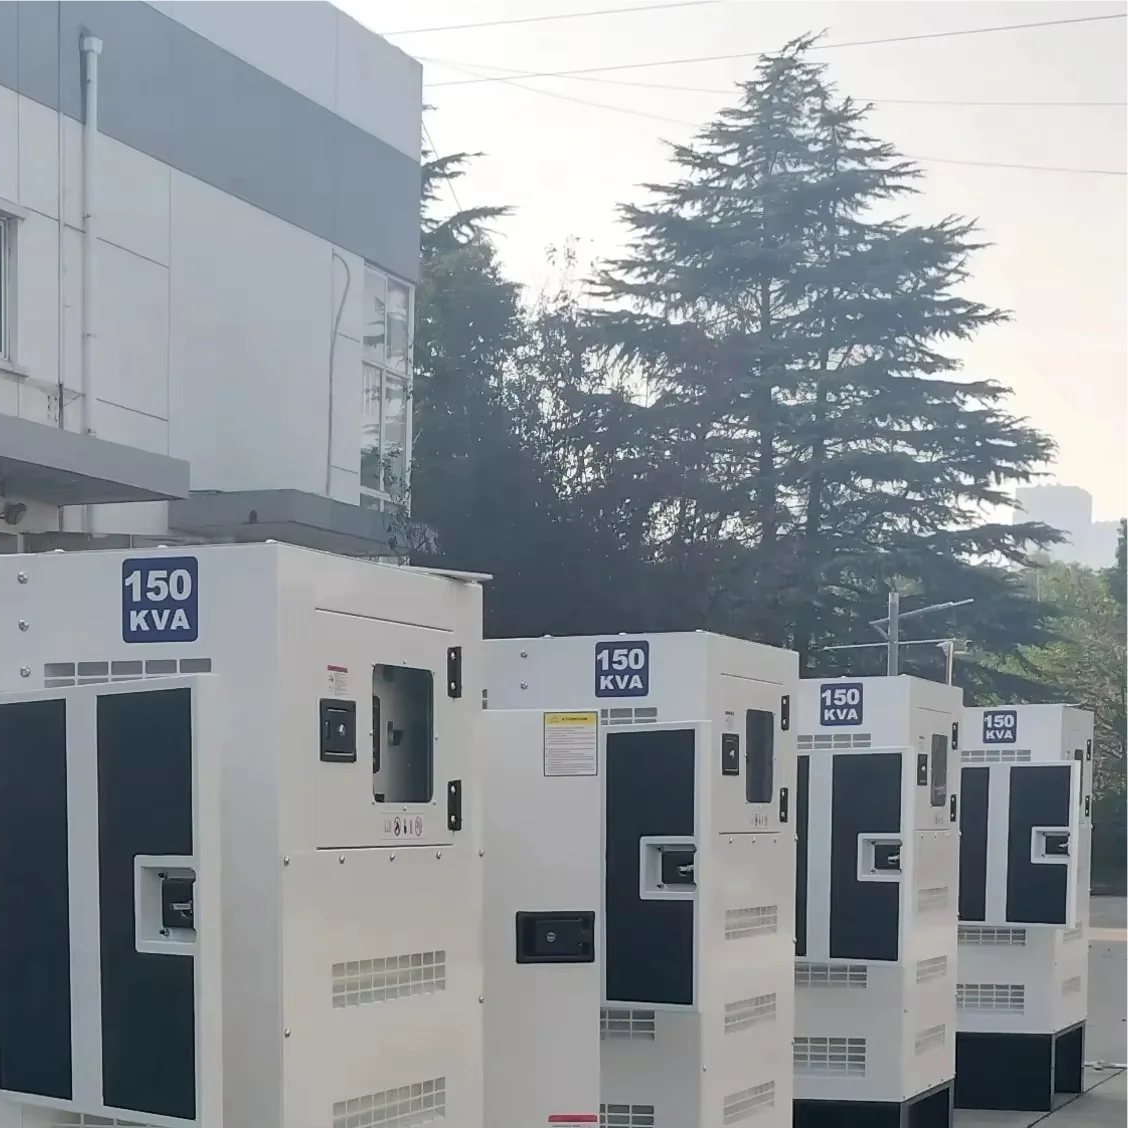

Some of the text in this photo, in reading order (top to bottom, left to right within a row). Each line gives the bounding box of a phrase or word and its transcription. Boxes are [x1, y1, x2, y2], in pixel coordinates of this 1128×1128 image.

[124, 569, 192, 602] 150
[129, 608, 191, 632] KVA
[596, 648, 645, 671] 150
[599, 674, 644, 690] KVA
[821, 688, 860, 706] 150
[824, 708, 859, 721] KVA
[984, 714, 1015, 728] 150
[986, 729, 1014, 740] KVA
